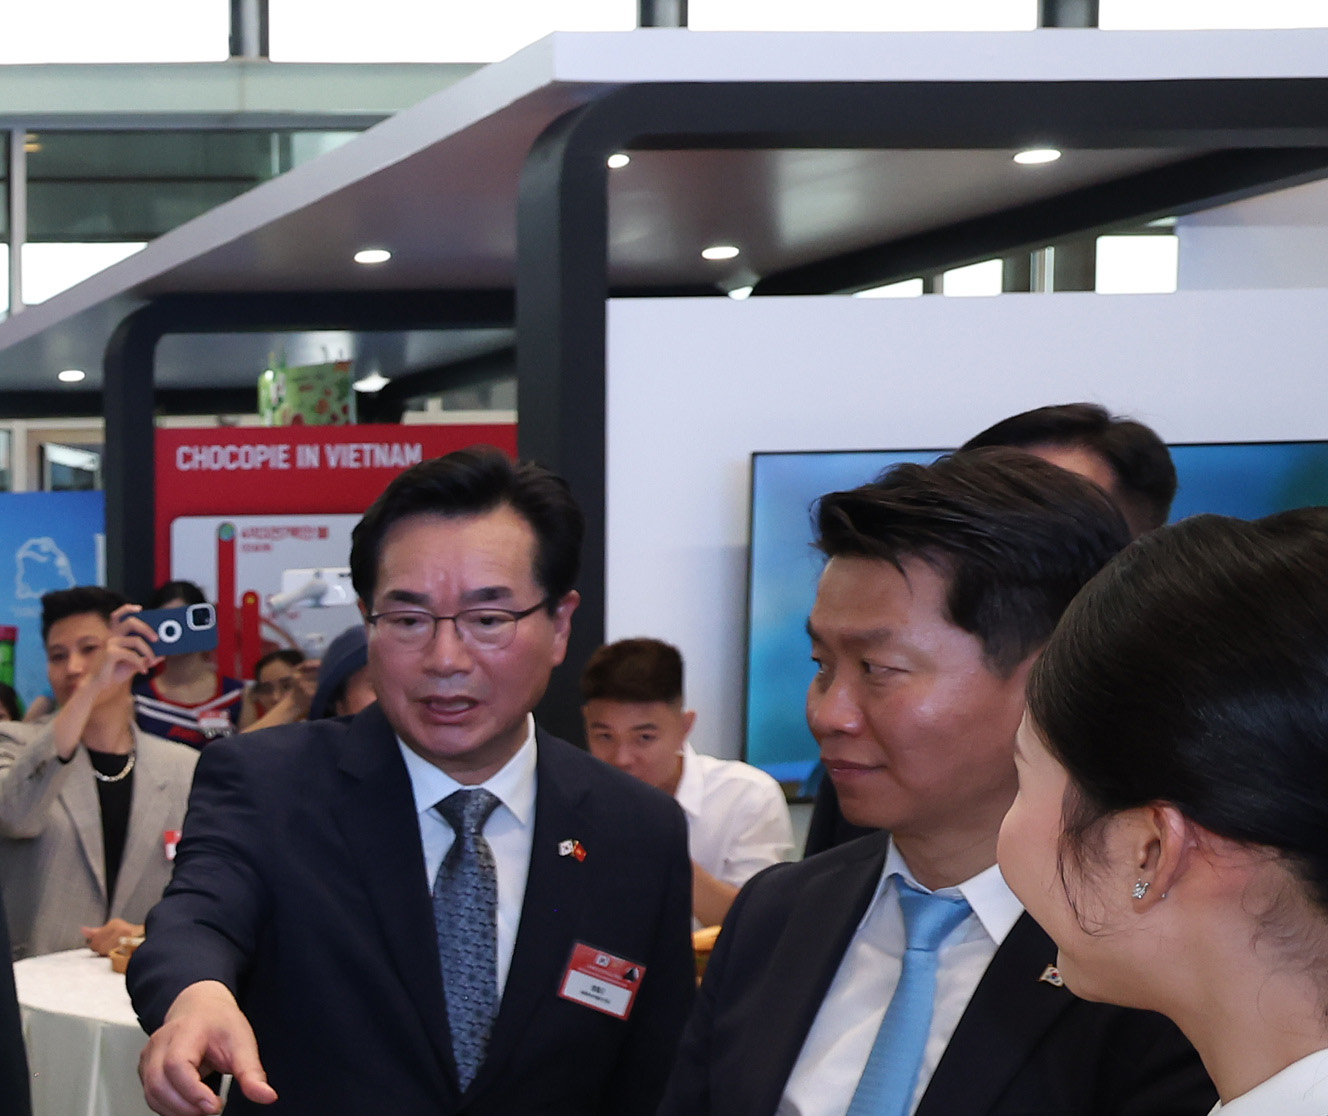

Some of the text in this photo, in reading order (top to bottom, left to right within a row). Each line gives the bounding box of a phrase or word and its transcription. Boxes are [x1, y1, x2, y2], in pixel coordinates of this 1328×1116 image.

[176, 442, 423, 471] CHOCOPIE IN VIETNAM
